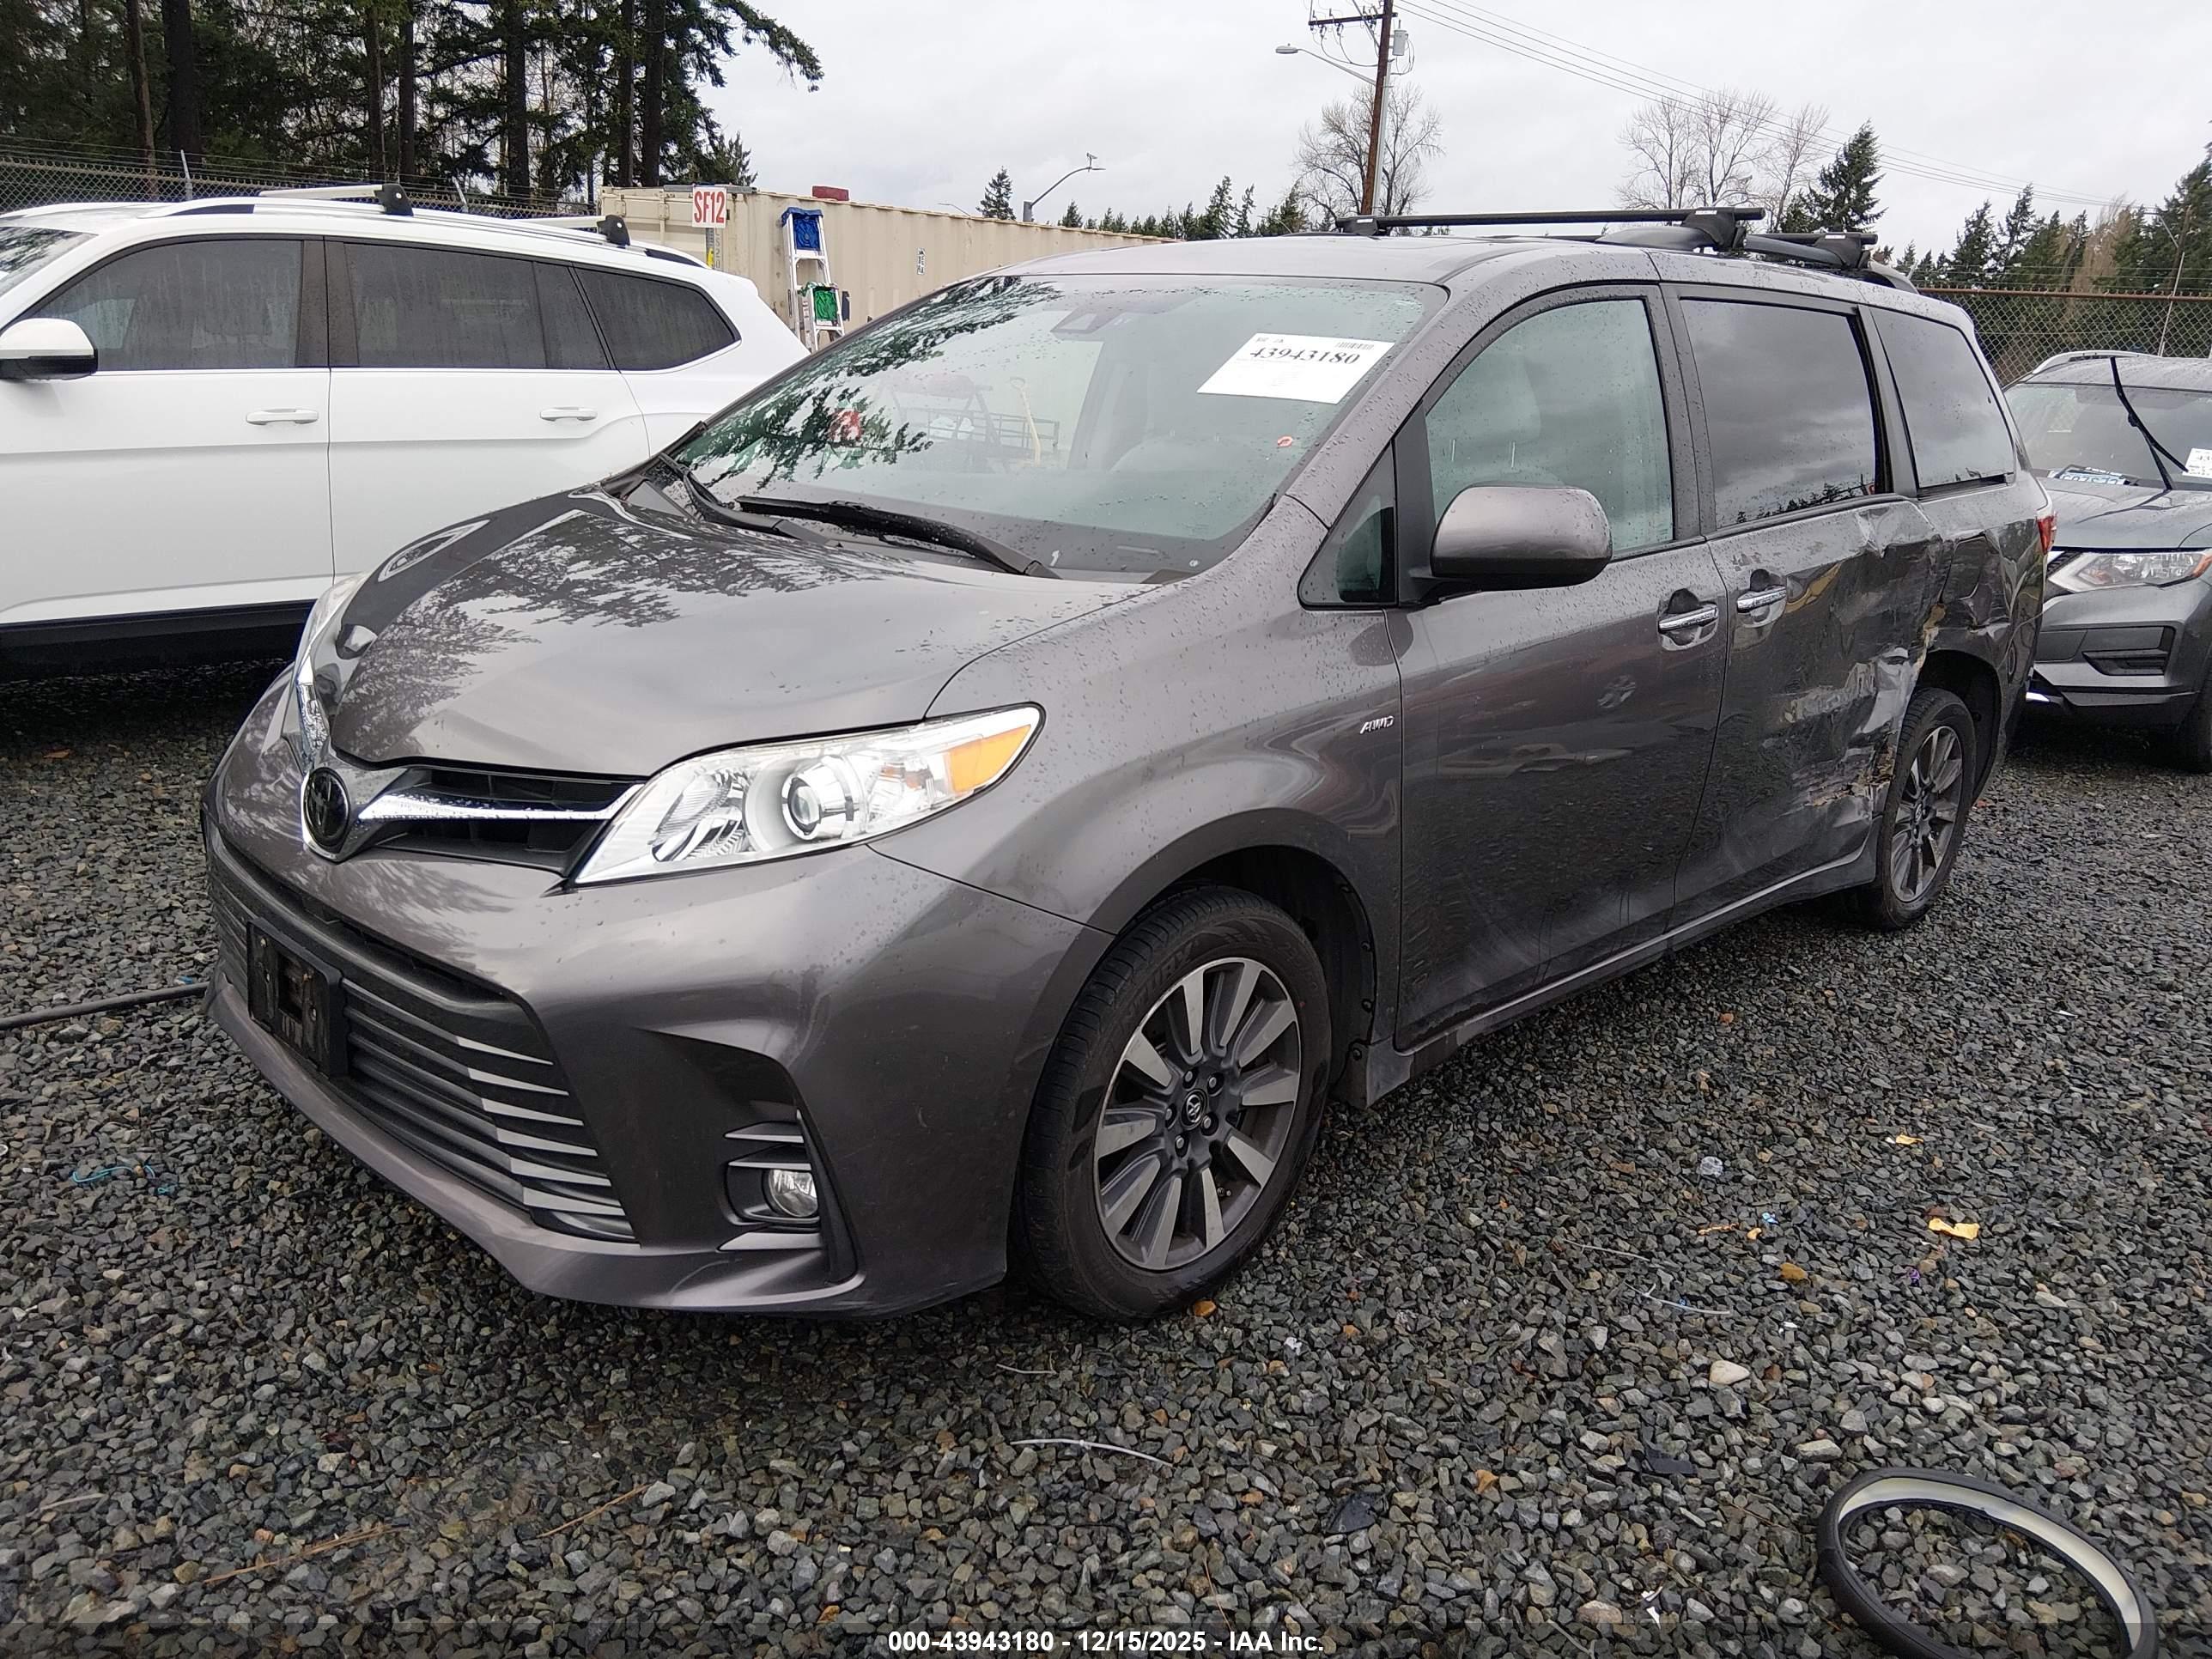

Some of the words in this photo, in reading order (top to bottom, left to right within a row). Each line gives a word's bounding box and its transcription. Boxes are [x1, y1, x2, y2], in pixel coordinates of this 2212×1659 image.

[694, 191, 725, 223] SF12
[1249, 346, 1361, 365] 43943180
[1359, 715, 1395, 734] AWD
